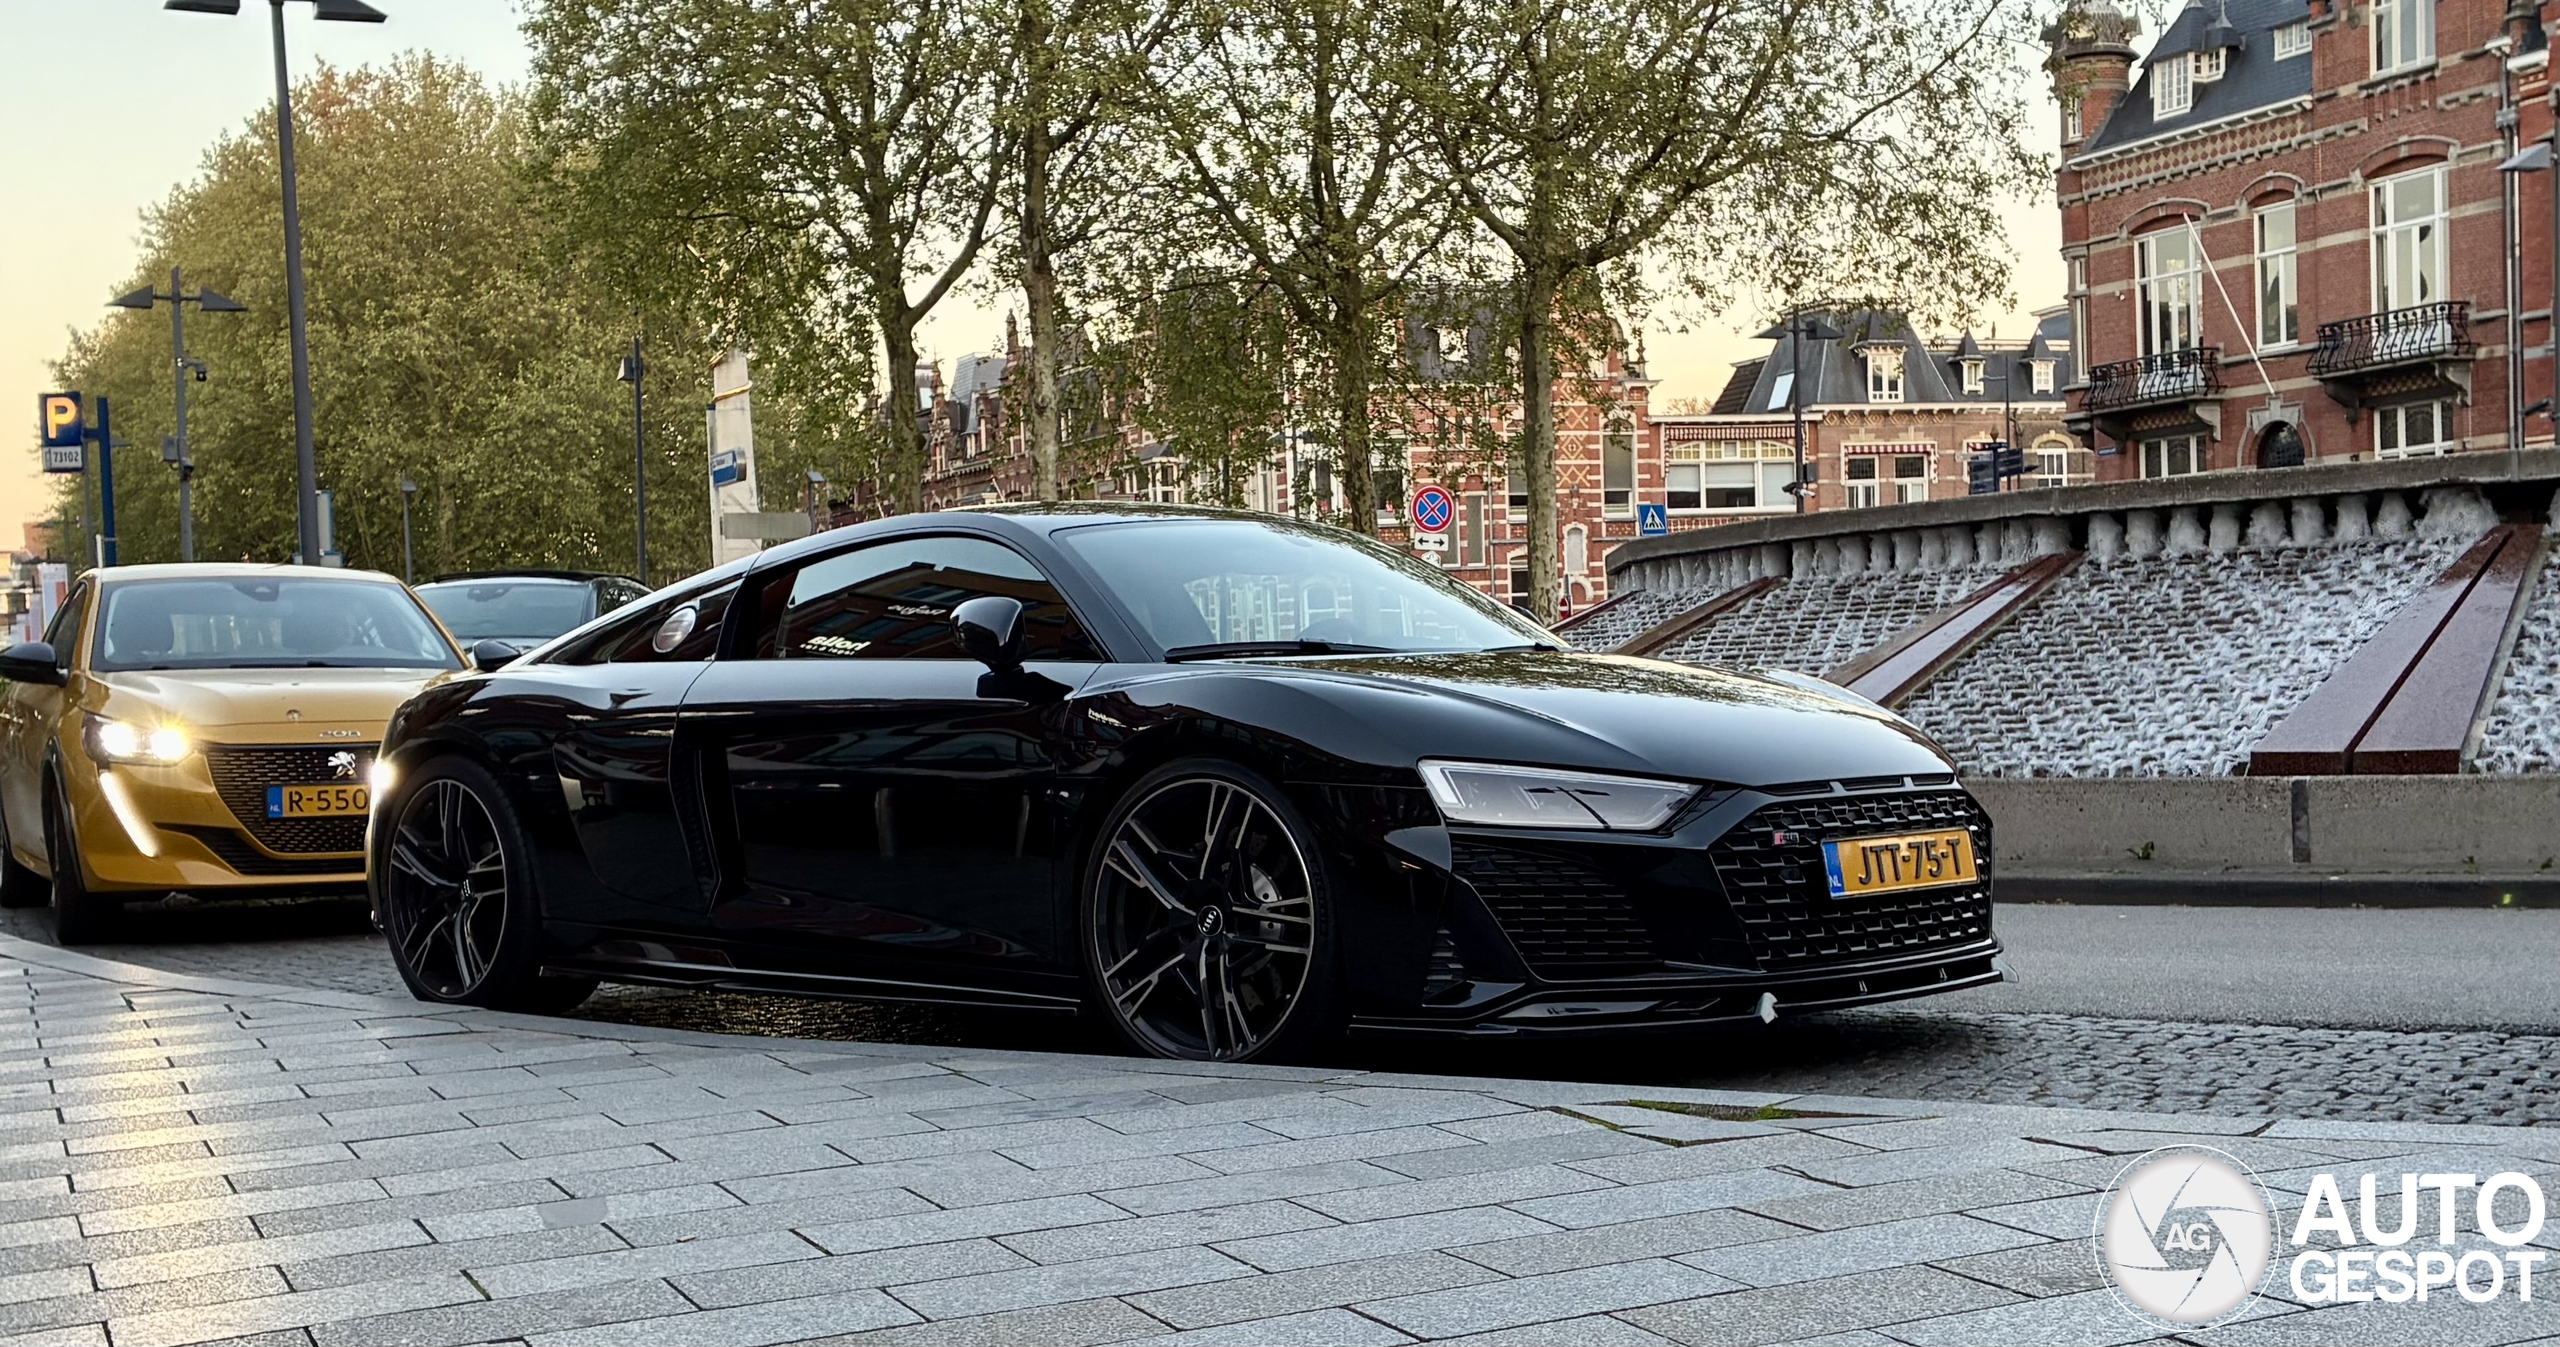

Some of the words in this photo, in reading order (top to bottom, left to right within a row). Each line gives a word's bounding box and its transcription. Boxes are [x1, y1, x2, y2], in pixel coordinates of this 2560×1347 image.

[46, 397, 77, 439] P
[53, 450, 79, 463] 73102
[1859, 837, 1961, 885] JTT-75-T
[1829, 875, 1842, 888] NL
